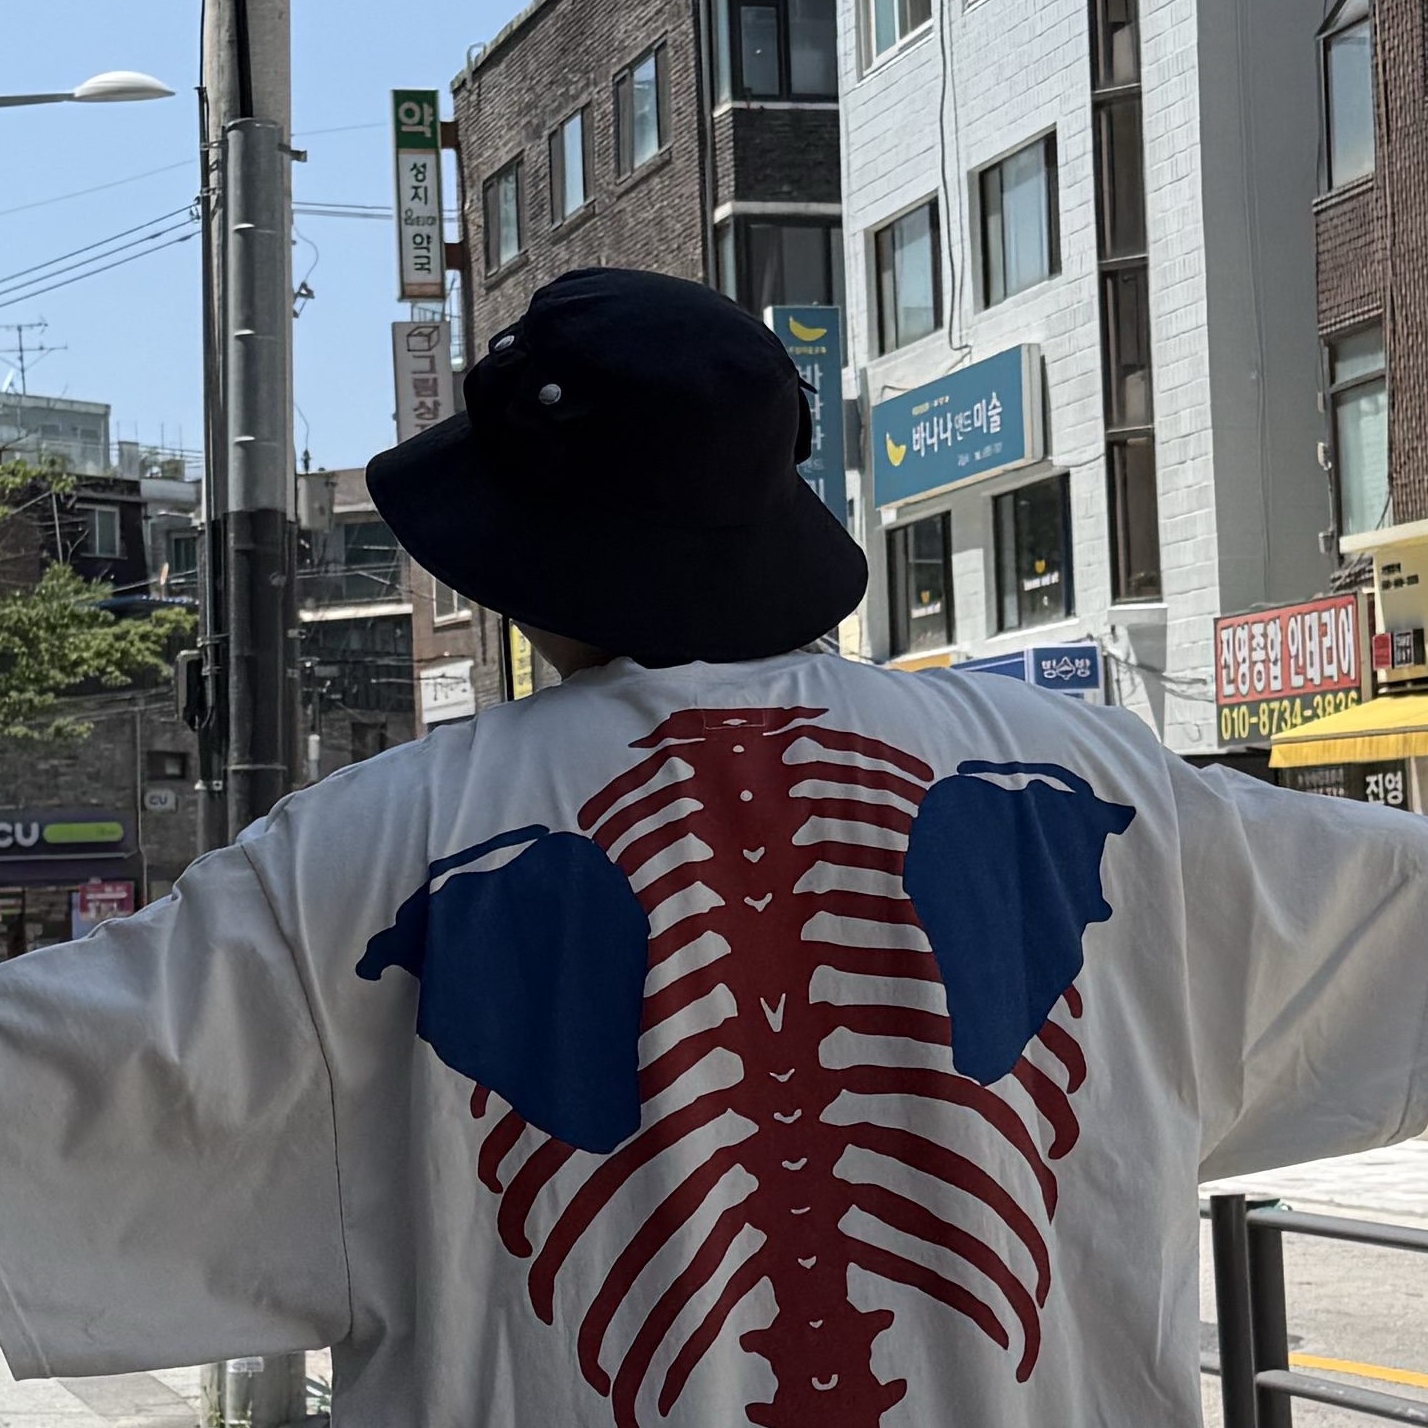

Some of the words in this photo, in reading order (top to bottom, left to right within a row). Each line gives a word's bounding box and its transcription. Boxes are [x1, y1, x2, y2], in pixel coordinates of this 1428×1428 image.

[398, 101, 433, 138] 약
[410, 162, 428, 205] 성지
[412, 233, 431, 274] 약국
[411, 355, 441, 430] 그림상
[912, 412, 953, 457] 바나나
[973, 391, 1003, 434] 미술
[1220, 618, 1283, 697] 진영종합
[1287, 604, 1356, 688] 인테리어
[149, 795, 169, 806] CU
[1366, 770, 1404, 805] 진영
